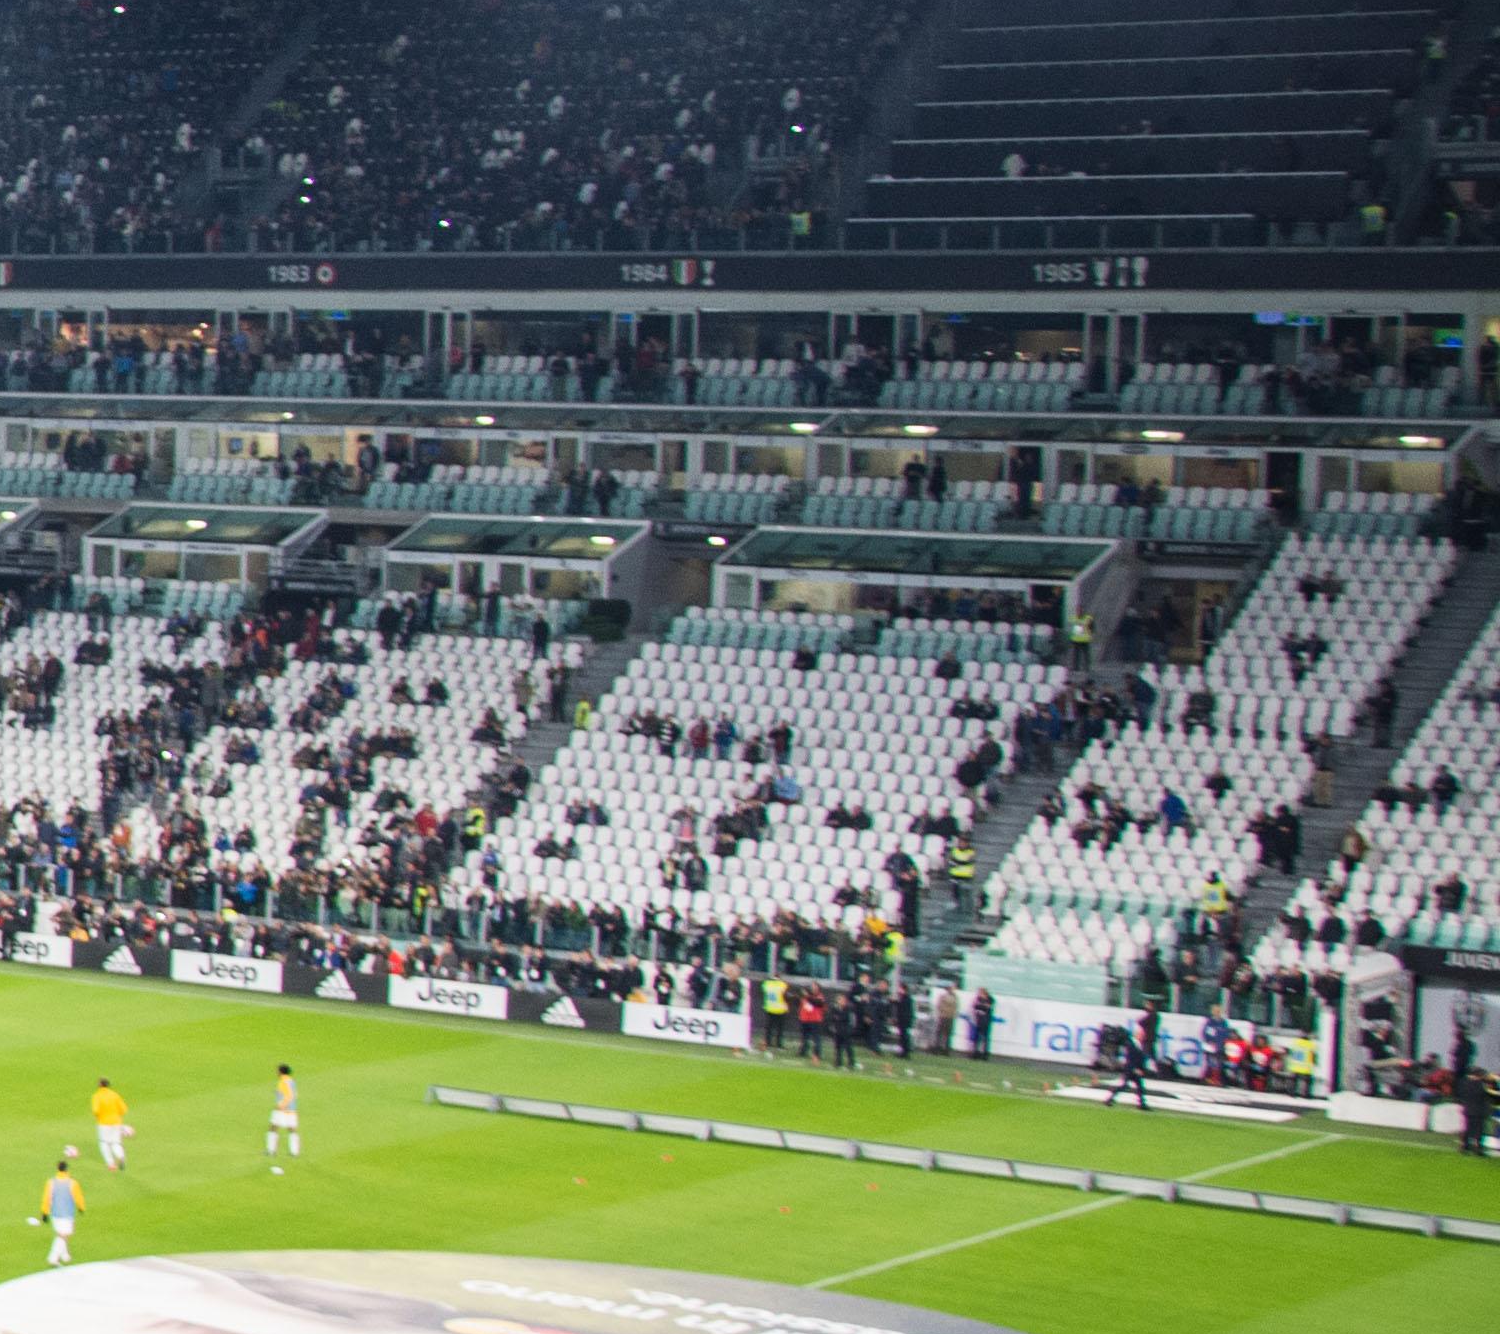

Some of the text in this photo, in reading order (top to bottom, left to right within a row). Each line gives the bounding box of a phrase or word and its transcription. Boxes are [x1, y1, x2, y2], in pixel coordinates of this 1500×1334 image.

[268, 265, 311, 283] 1983
[620, 264, 666, 283] 1984
[1033, 264, 1085, 283] 1985
[198, 953, 257, 986] Jeep
[416, 981, 483, 1012] Jeep
[652, 1008, 721, 1040] Jeep
